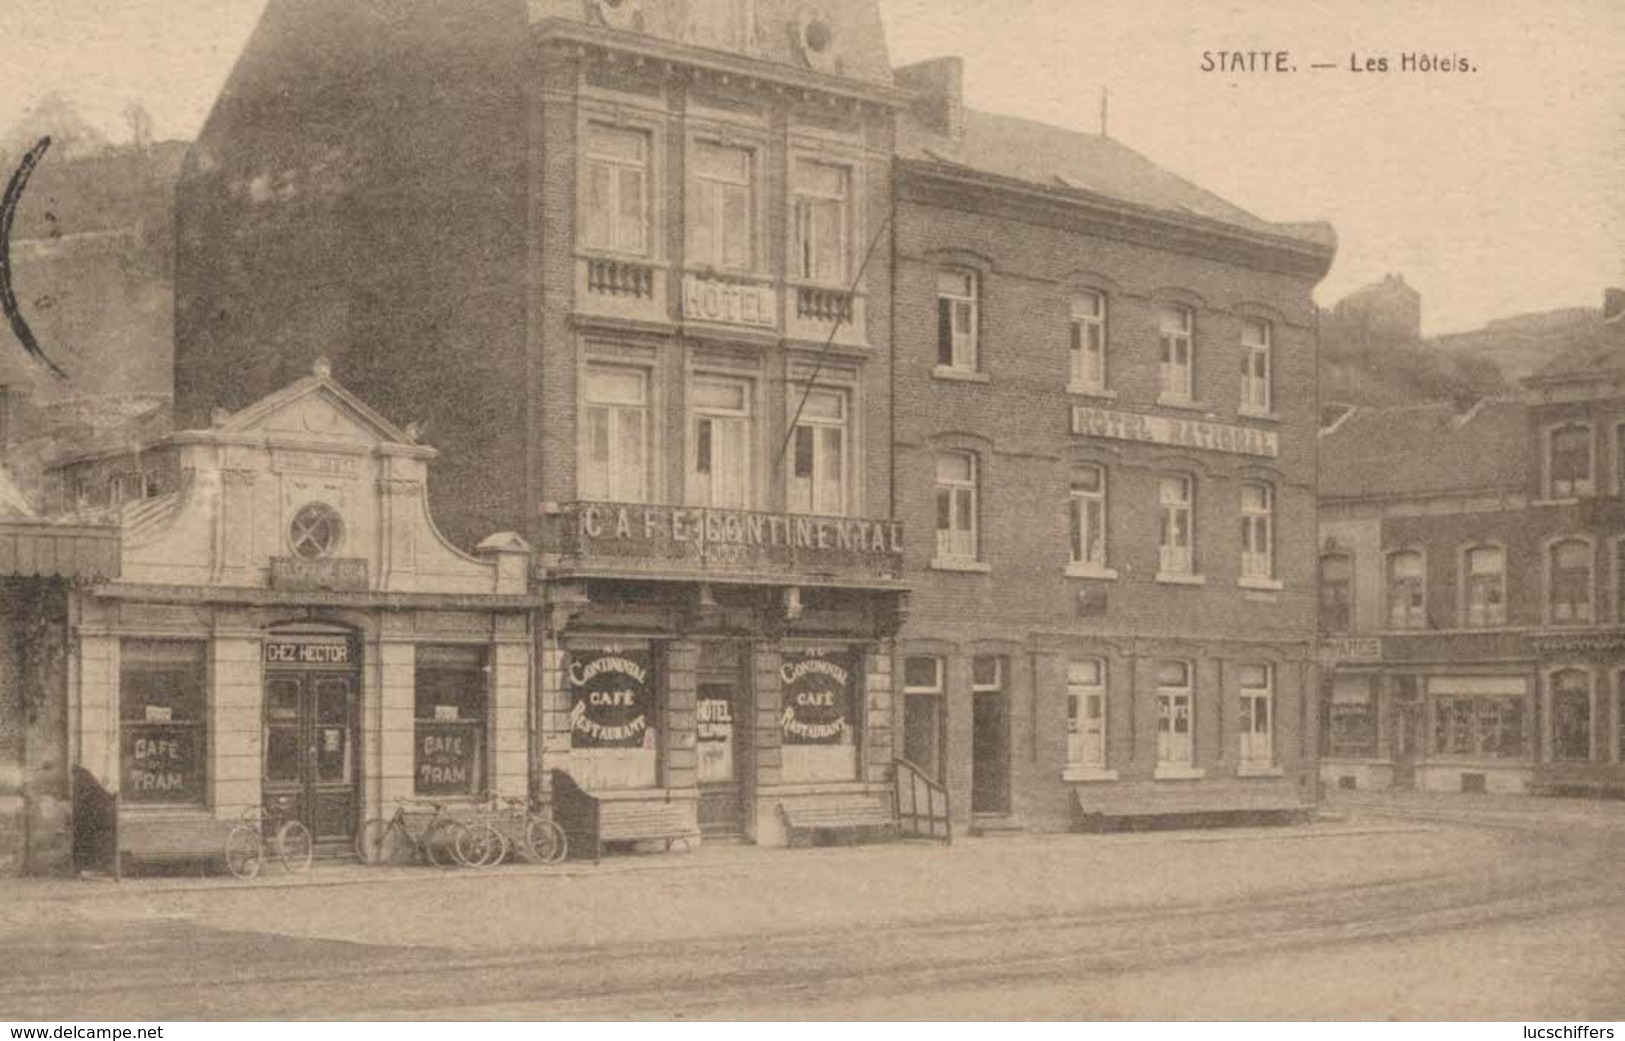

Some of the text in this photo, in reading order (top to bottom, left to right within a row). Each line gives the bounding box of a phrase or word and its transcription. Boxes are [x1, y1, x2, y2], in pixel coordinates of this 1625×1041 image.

[585, 507, 904, 552] CAFE CONTINENTAL
[267, 644, 348, 663] CHEZ HECTOR
[131, 769, 182, 790] TRAM
[421, 765, 467, 785] TRAM
